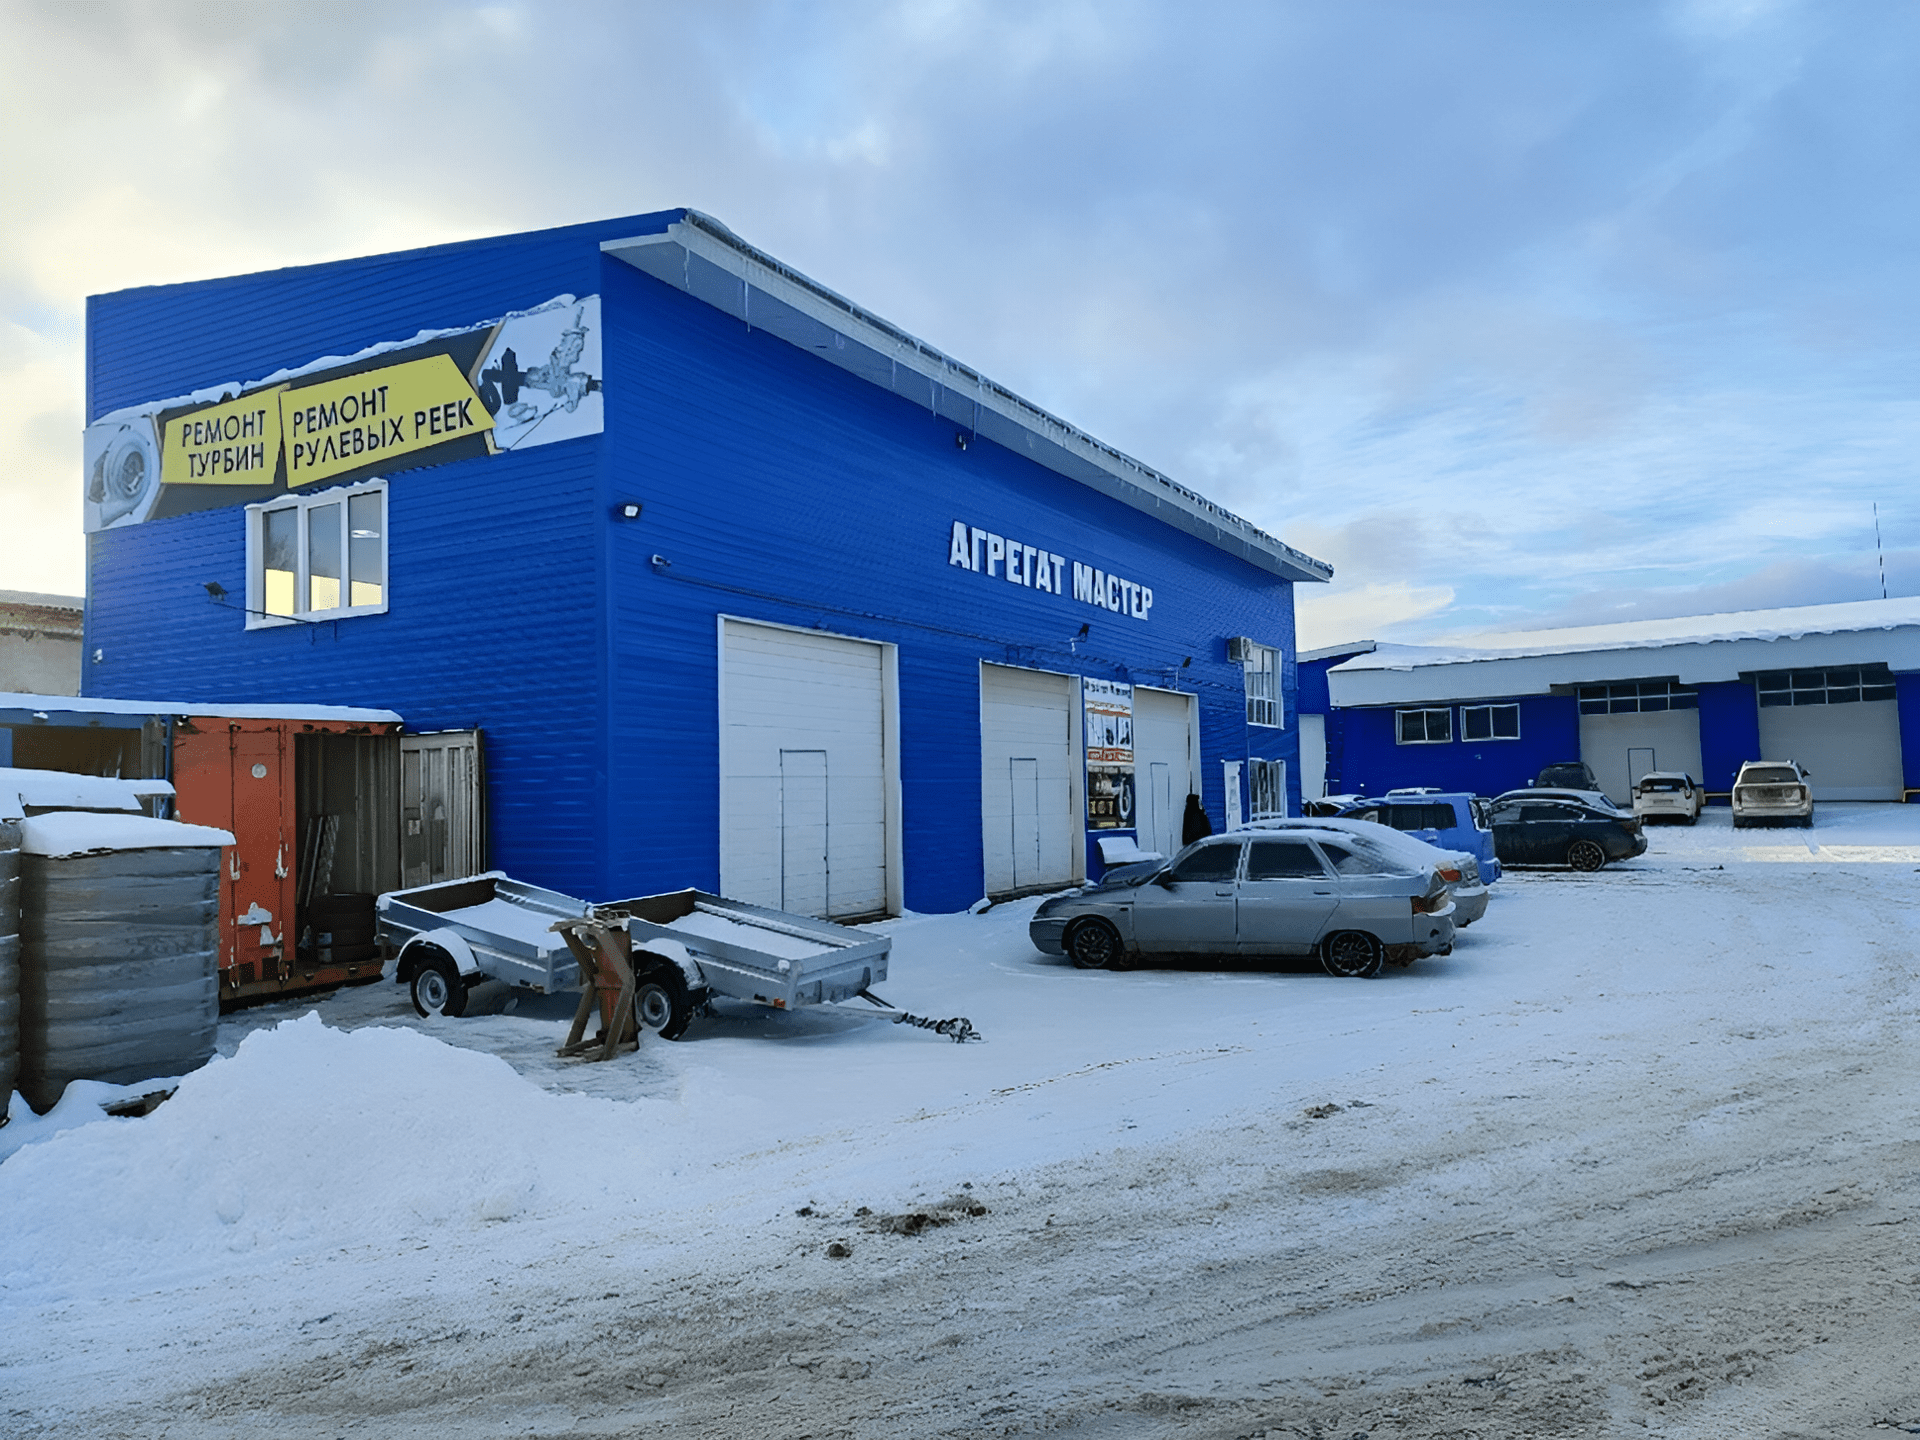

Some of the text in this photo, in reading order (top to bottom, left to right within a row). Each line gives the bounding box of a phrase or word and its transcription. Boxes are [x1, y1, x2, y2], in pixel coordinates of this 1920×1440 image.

[182, 411, 266, 447] РЕМОНТ
[293, 386, 389, 437] РЕМОНТ
[293, 398, 475, 470] РУЛЕВЫХ РЕЕК
[188, 443, 264, 478] ТУРБИН
[949, 521, 1153, 620] АГРЕГАТ МАСТЕР
